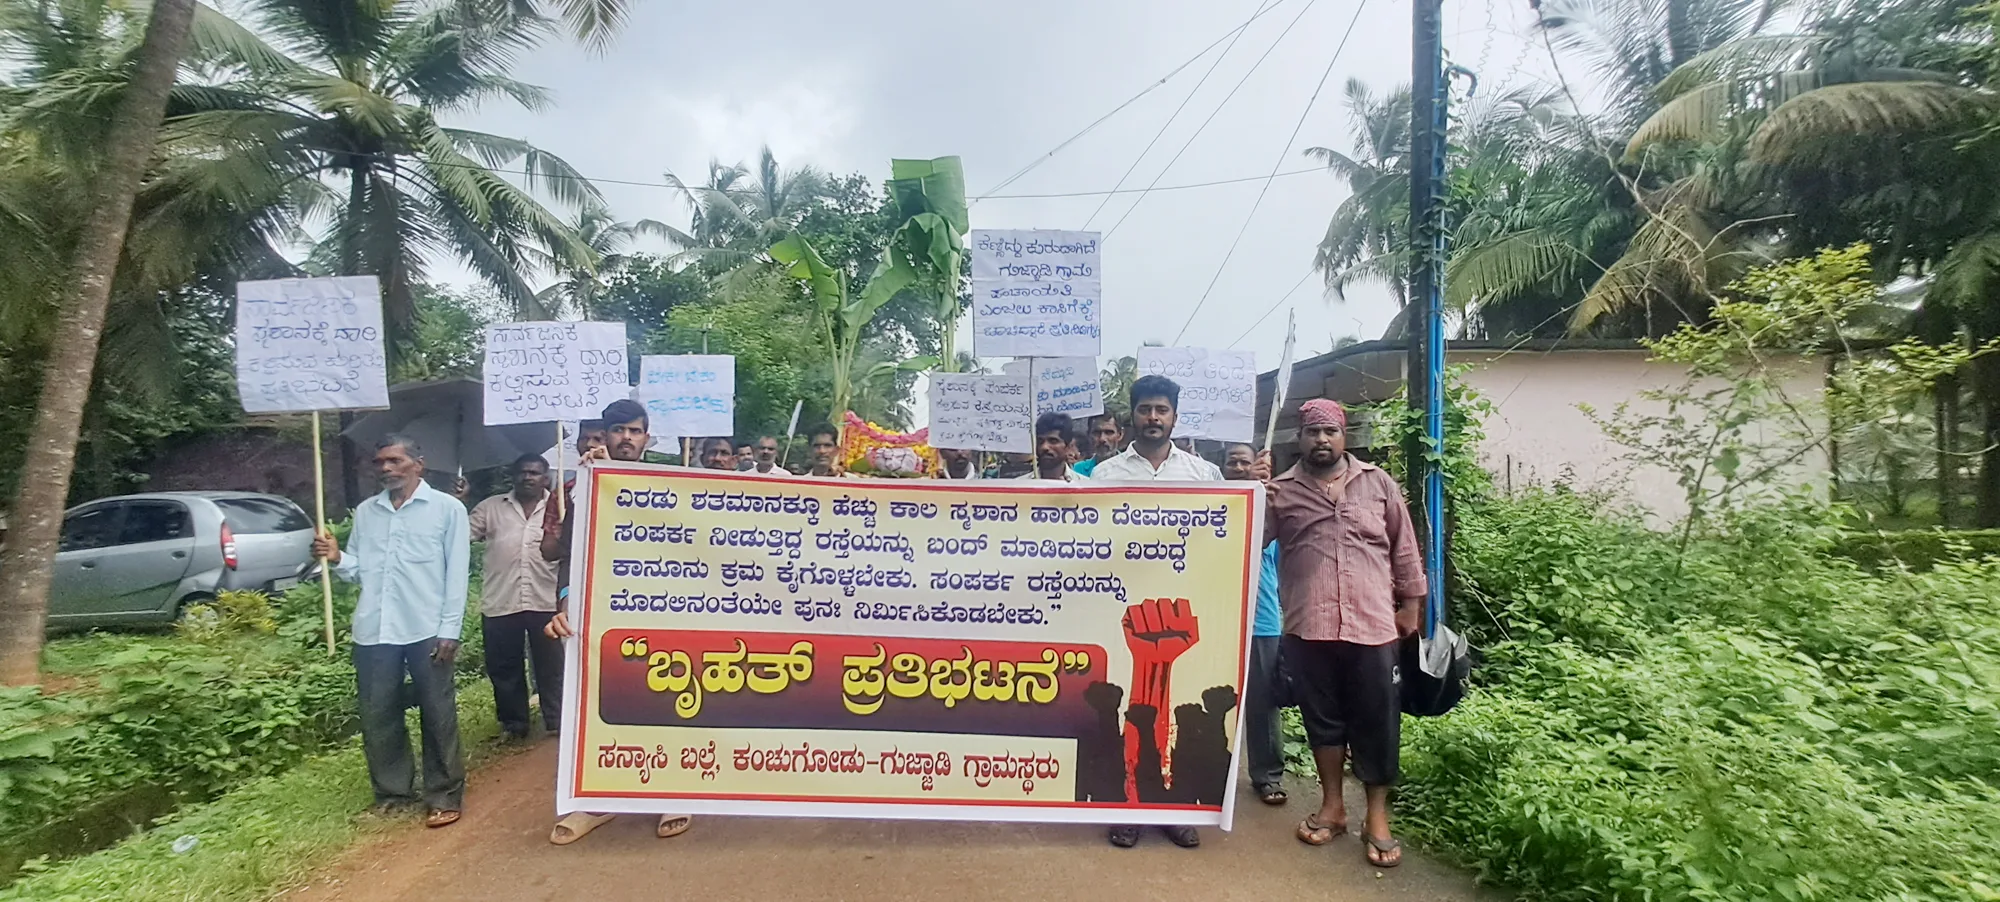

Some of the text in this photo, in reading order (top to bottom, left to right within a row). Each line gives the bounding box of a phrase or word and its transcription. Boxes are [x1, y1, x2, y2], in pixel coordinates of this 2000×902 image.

[1055, 263, 1092, 281] ಗ್ರಾಮ
[990, 284, 1073, 299] ಪಂಚಾಯತಿ
[980, 302, 1032, 316] ಎಂಜಲು
[252, 319, 377, 348] ಸ್ಮಶಾನಕ್ಕೆ ದಾರಿ
[490, 343, 623, 369] ಸ್ಮಶಾನಕ್ಕೆ ದಾರಿ
[260, 370, 361, 404] ಪ್ರತಿಭಟನೆ
[504, 386, 600, 418] ಪ್ರತಿಭಟನೆ
[616, 486, 1228, 538] ಎರಡು ಶತಮಾನಕ್ಕೂ ಹೆಚ್ಚು ಕಾಲ ಸ್ಮಶಾನ ಹಾಗೂ ದೇವಸ್ಥಾನಕ್ಕೆ
[614, 520, 1187, 573] ಸಂಪರ್ಕ ನೀಡುತ್ತಿದ್ದ ರಸ್ತೆಯನ್ನು ಬಂದ್ ಮಾಡಿದವರ ವಿರುದ್ಧ
[613, 555, 1127, 602] ಕಾನೂನು ಕ್ರಮ ಕೈಗೊಳ್ಳಬೇಕು. ಸಂಪರ್ಕ ರಸ್ತೆಯನ್ನು
[610, 589, 782, 615] ಮೊದಲಿನಂತೆಯೇ
[794, 596, 841, 622] ಪುನಃ
[620, 636, 1091, 719] “ಬೃಹತ್ ಪ್ರತಿಭಟನೆ”
[598, 738, 668, 784] ಸನ್ಯಾಸಿ
[680, 740, 720, 781] ಬಲ್ಲೆ,
[964, 749, 1060, 795] ಗ್ರಾಮಸ್ಥರು
